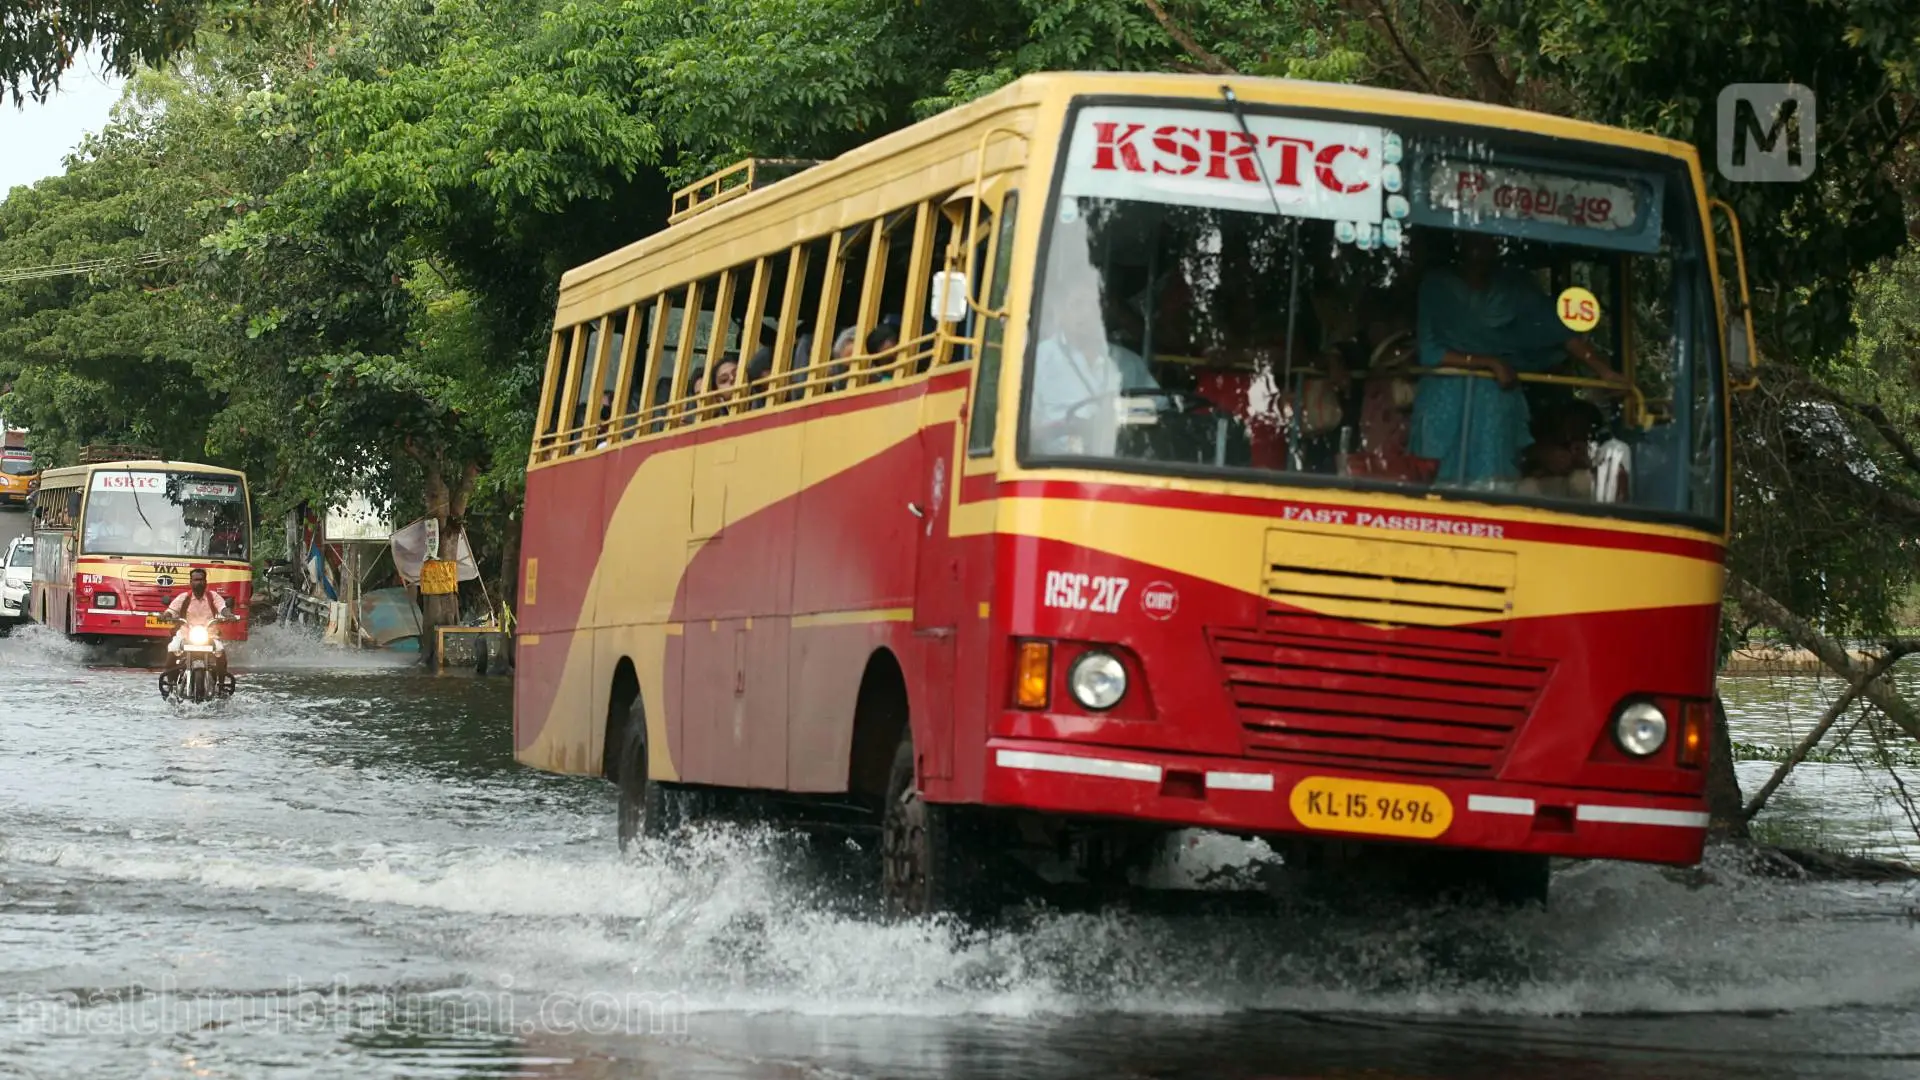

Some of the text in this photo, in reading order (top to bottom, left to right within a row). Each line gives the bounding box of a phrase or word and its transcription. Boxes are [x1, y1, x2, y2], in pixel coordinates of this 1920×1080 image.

[1092, 121, 1370, 194] KSRTC
[1562, 298, 1595, 322] LS
[103, 476, 160, 488] KSRTC
[1282, 506, 1505, 540] FAST PASSENGER
[154, 566, 179, 574] TATA
[1044, 570, 1130, 614] RSC 217
